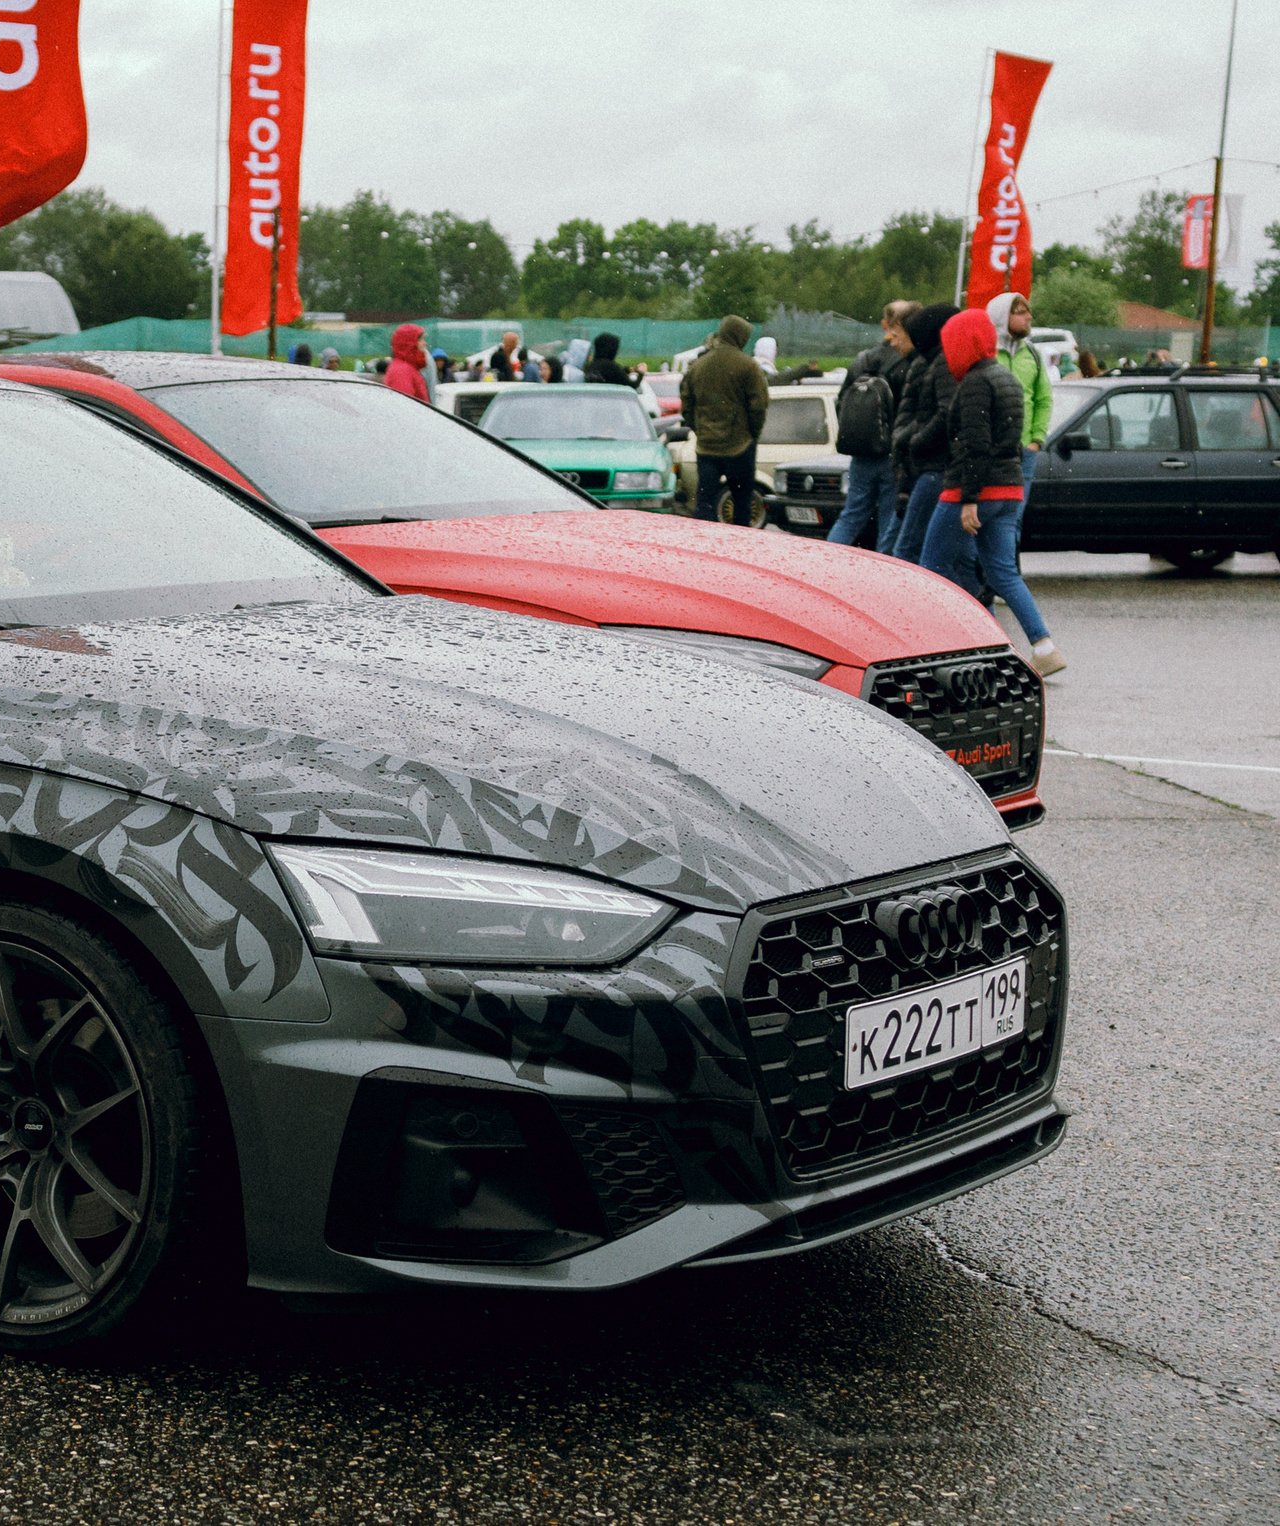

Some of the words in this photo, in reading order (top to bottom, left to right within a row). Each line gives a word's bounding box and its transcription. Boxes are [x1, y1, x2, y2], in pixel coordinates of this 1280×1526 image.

[243, 43, 283, 248] auto.ru
[990, 122, 1021, 271] auto.ru
[957, 747, 982, 765] Audi
[983, 741, 1011, 764] Sport
[861, 998, 978, 1075] K222TT
[985, 969, 1021, 1019] 199
[996, 1018, 1014, 1036] RUS
